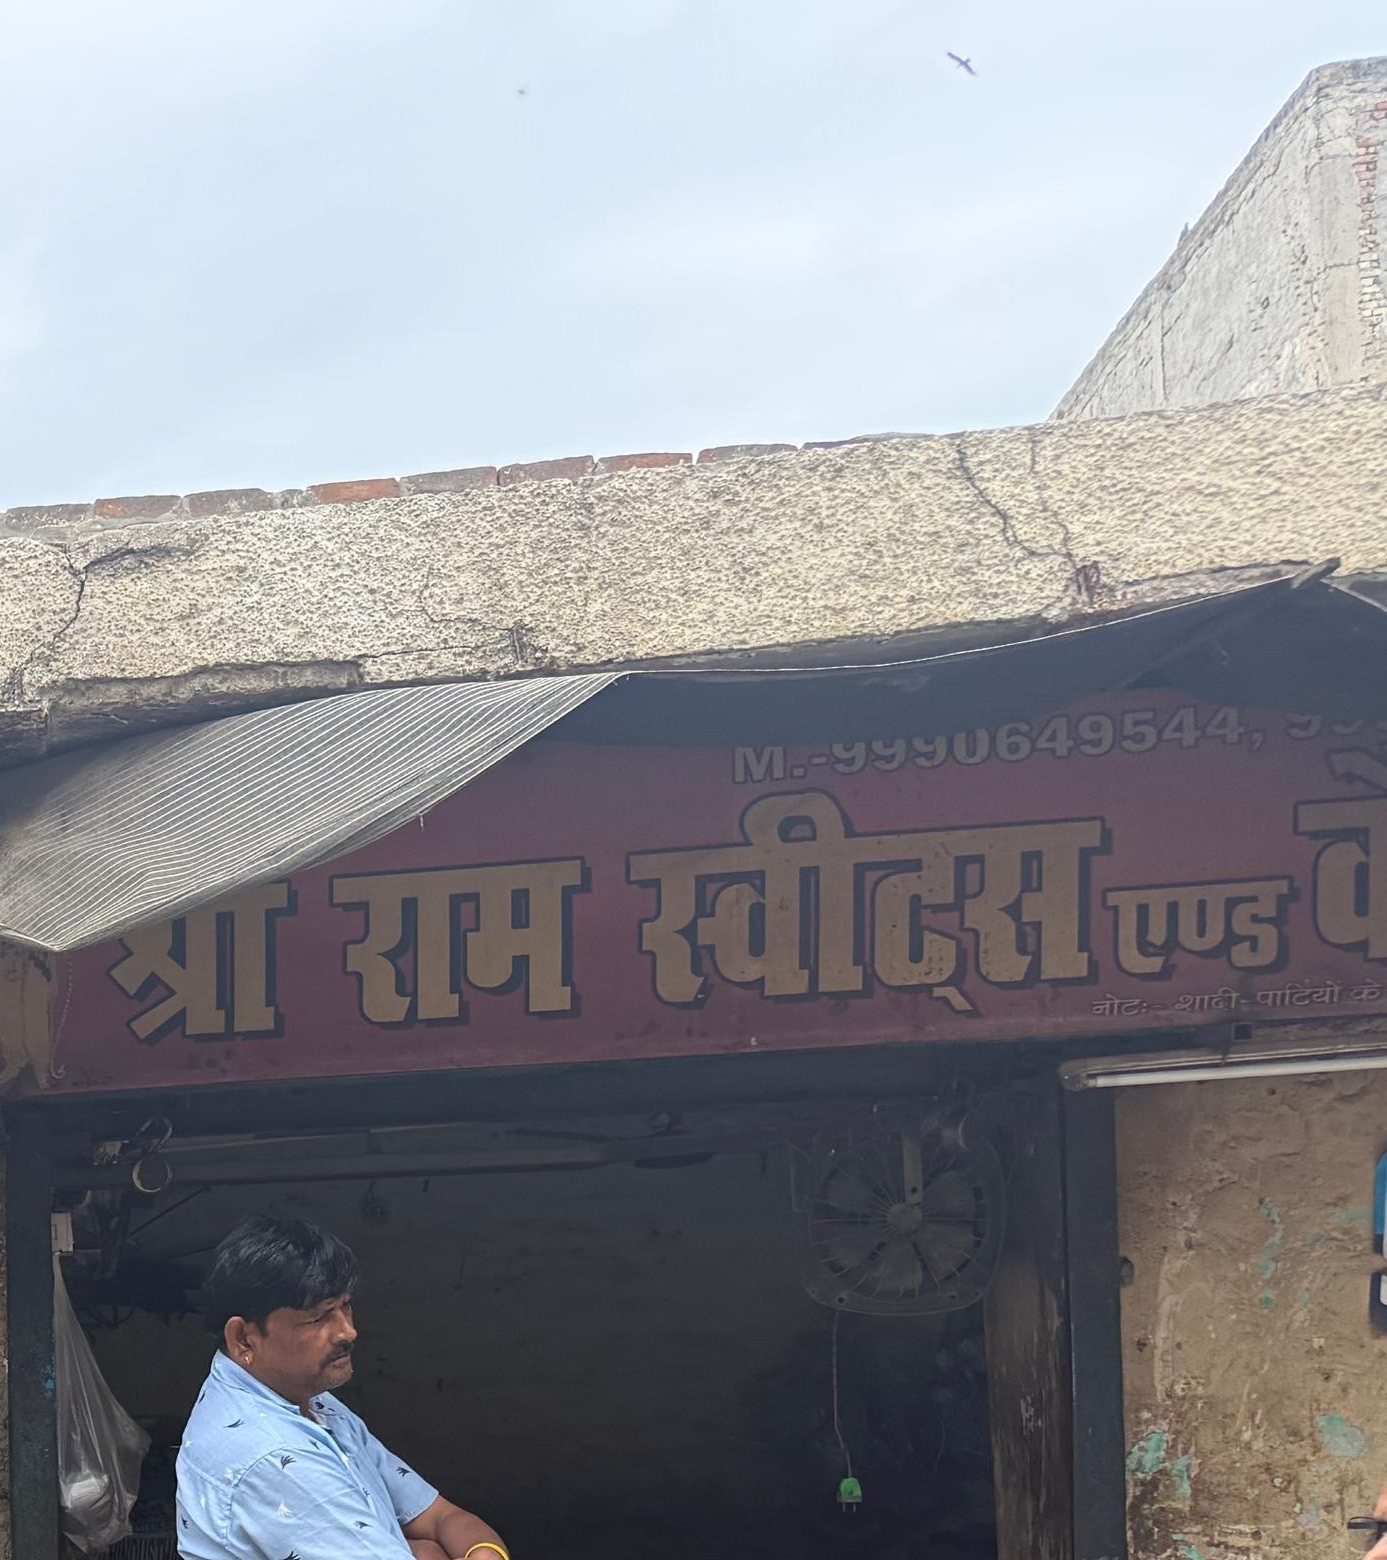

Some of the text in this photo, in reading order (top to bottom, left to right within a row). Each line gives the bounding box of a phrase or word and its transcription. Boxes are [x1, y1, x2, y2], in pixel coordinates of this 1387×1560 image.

[330, 858, 587, 1026] राम
[627, 795, 1107, 1014] स्वीट्स
[1107, 877, 1293, 975] एण्ड
